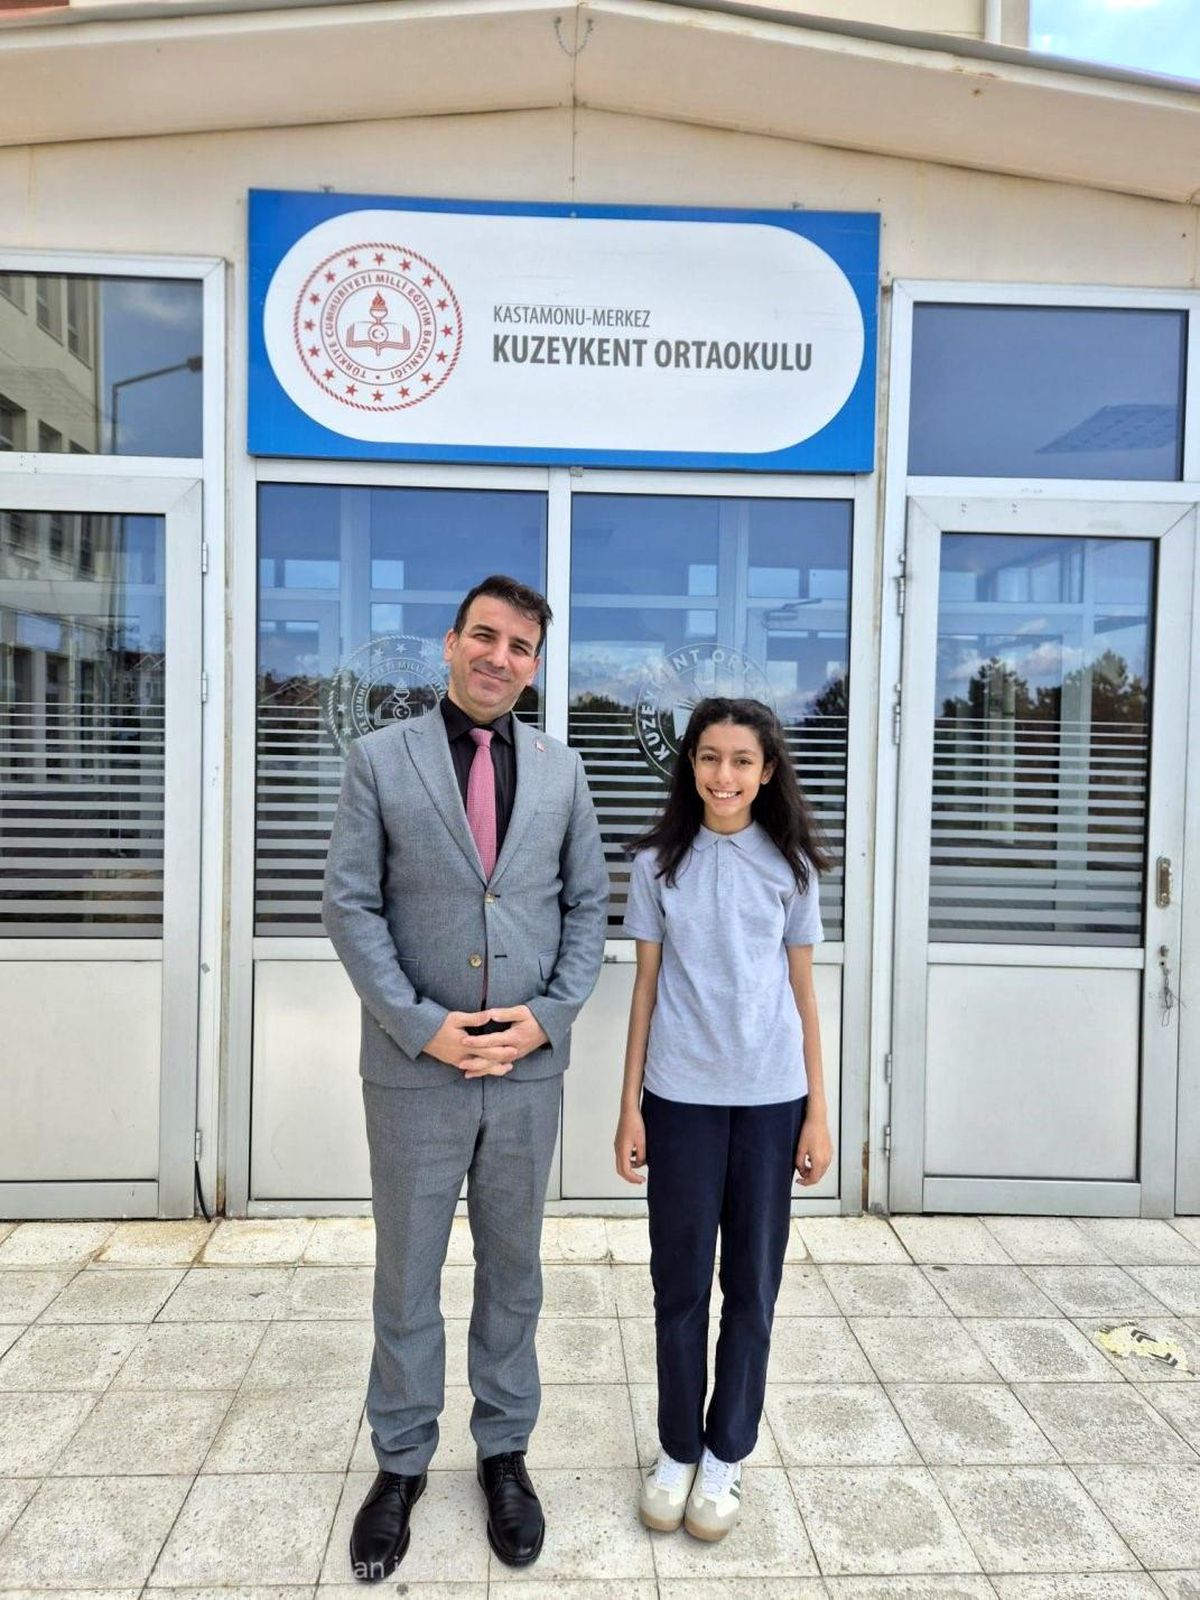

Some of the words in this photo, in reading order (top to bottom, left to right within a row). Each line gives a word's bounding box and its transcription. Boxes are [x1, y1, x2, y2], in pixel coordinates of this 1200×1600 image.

[375, 273, 406, 291] MİLLİ
[324, 274, 372, 337] CUMHURİYETİ
[407, 287, 432, 326] EĞİTİM
[493, 305, 651, 328] KASTAMONU-MERKEZ
[328, 342, 366, 379] TÜRKİYE
[390, 330, 432, 380] BAKANLIĞI
[493, 334, 648, 367] KUZEYKENT
[654, 339, 813, 371] ORTAOKULU
